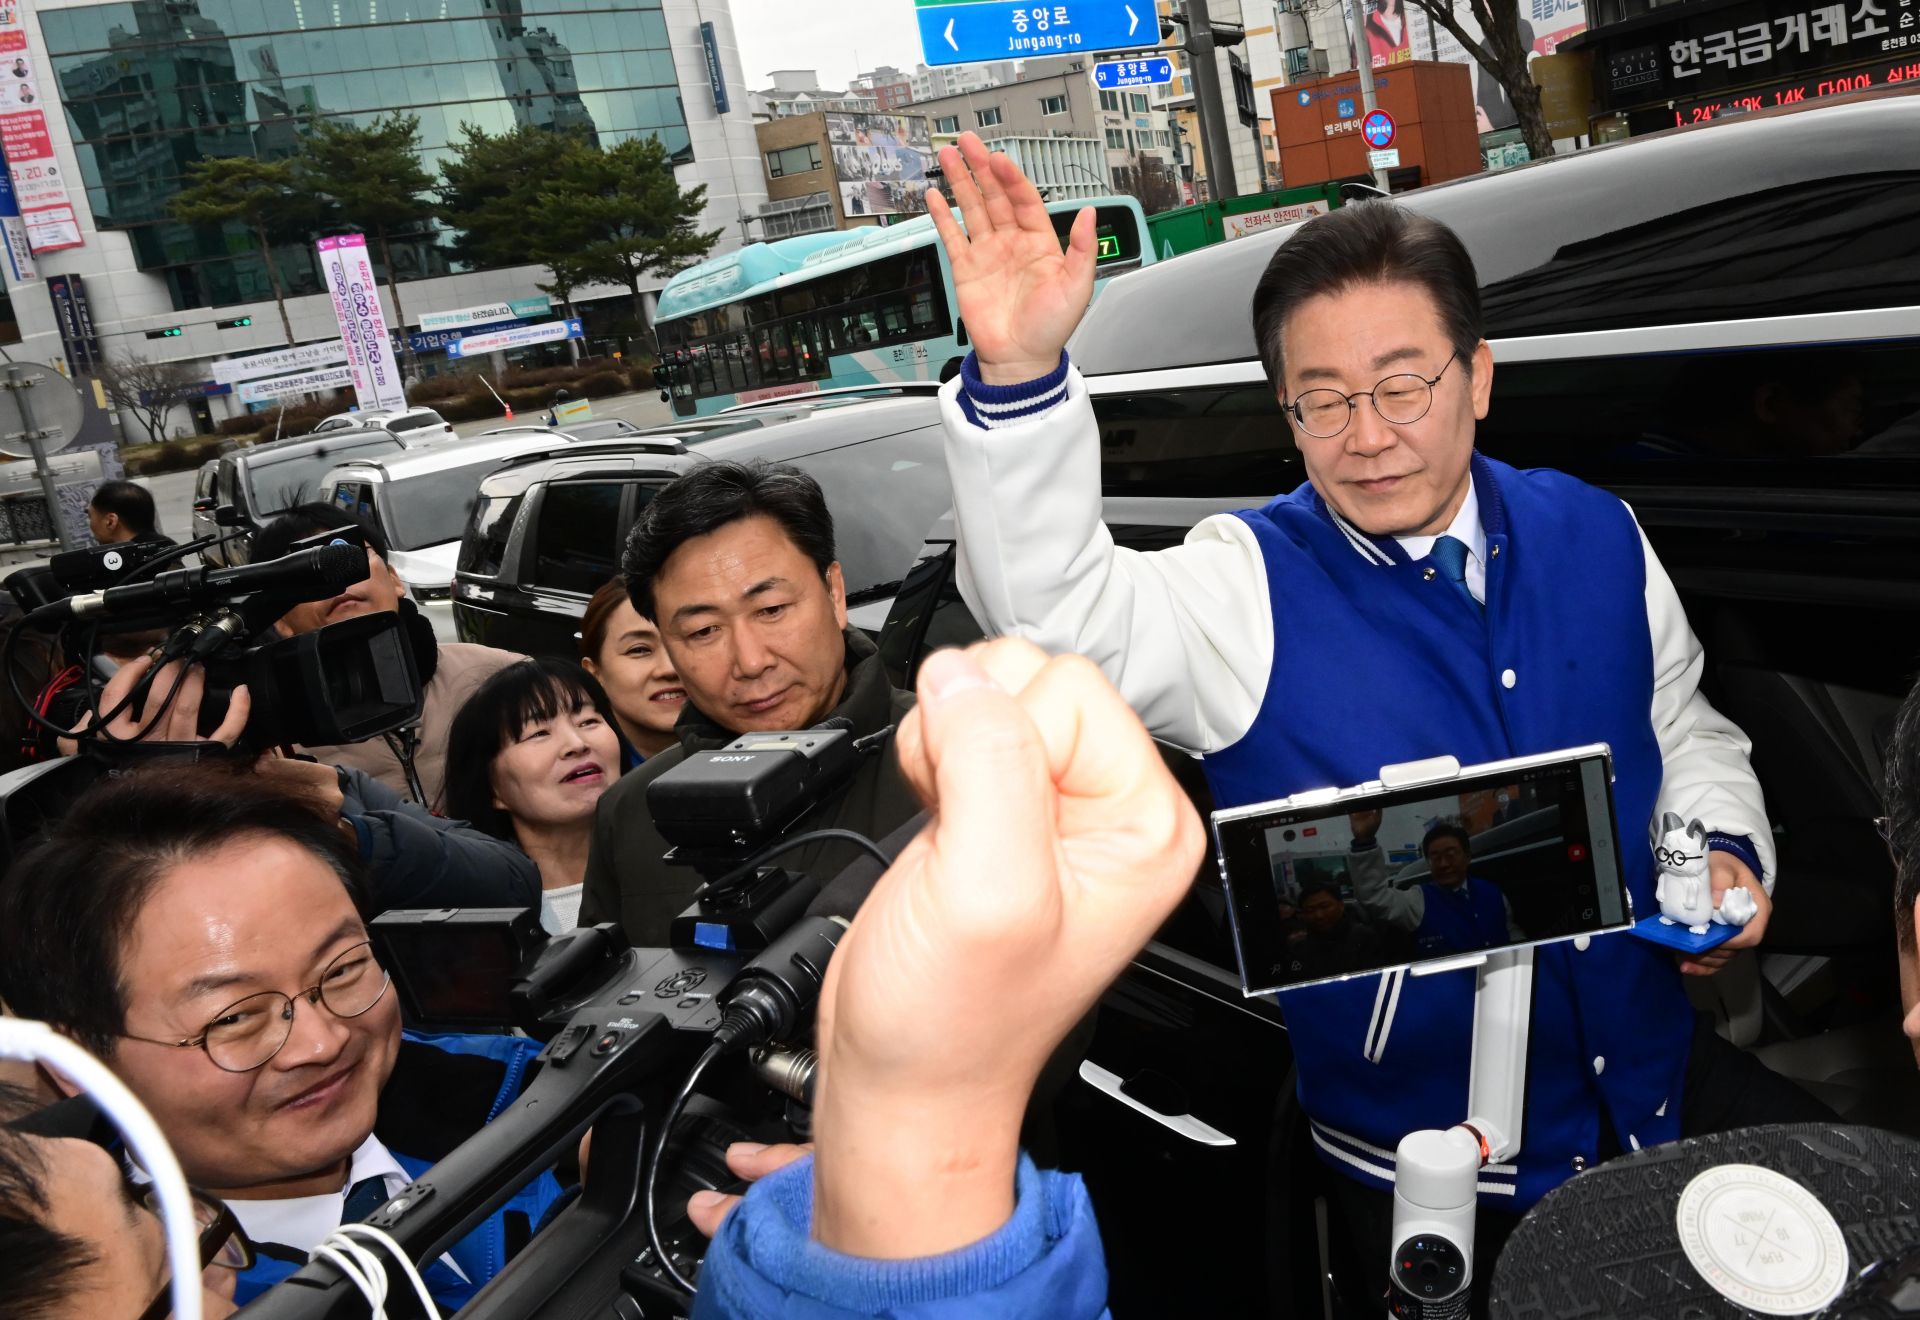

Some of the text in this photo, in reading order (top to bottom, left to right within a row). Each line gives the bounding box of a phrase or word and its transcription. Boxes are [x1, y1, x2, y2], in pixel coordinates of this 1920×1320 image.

[1011, 6, 1071, 33] 중앙로
[1008, 32, 1082, 51] Jungang-ro
[1668, 0, 1890, 79] 한국금거래소
[1881, 36, 1907, 51] 춘천점
[1098, 71, 1107, 82] 51
[1116, 62, 1149, 76] 중앙로
[1160, 66, 1169, 75] 47
[1611, 59, 1657, 78] GOLD
[1116, 74, 1152, 86] Jungang-ro
[1775, 87, 1805, 105] 14K
[1324, 118, 1361, 136] 엘리베이
[1243, 207, 1304, 229] 전좌석 안전띠!
[472, 306, 510, 320] 하겠습니다
[708, 754, 755, 764] SONY
